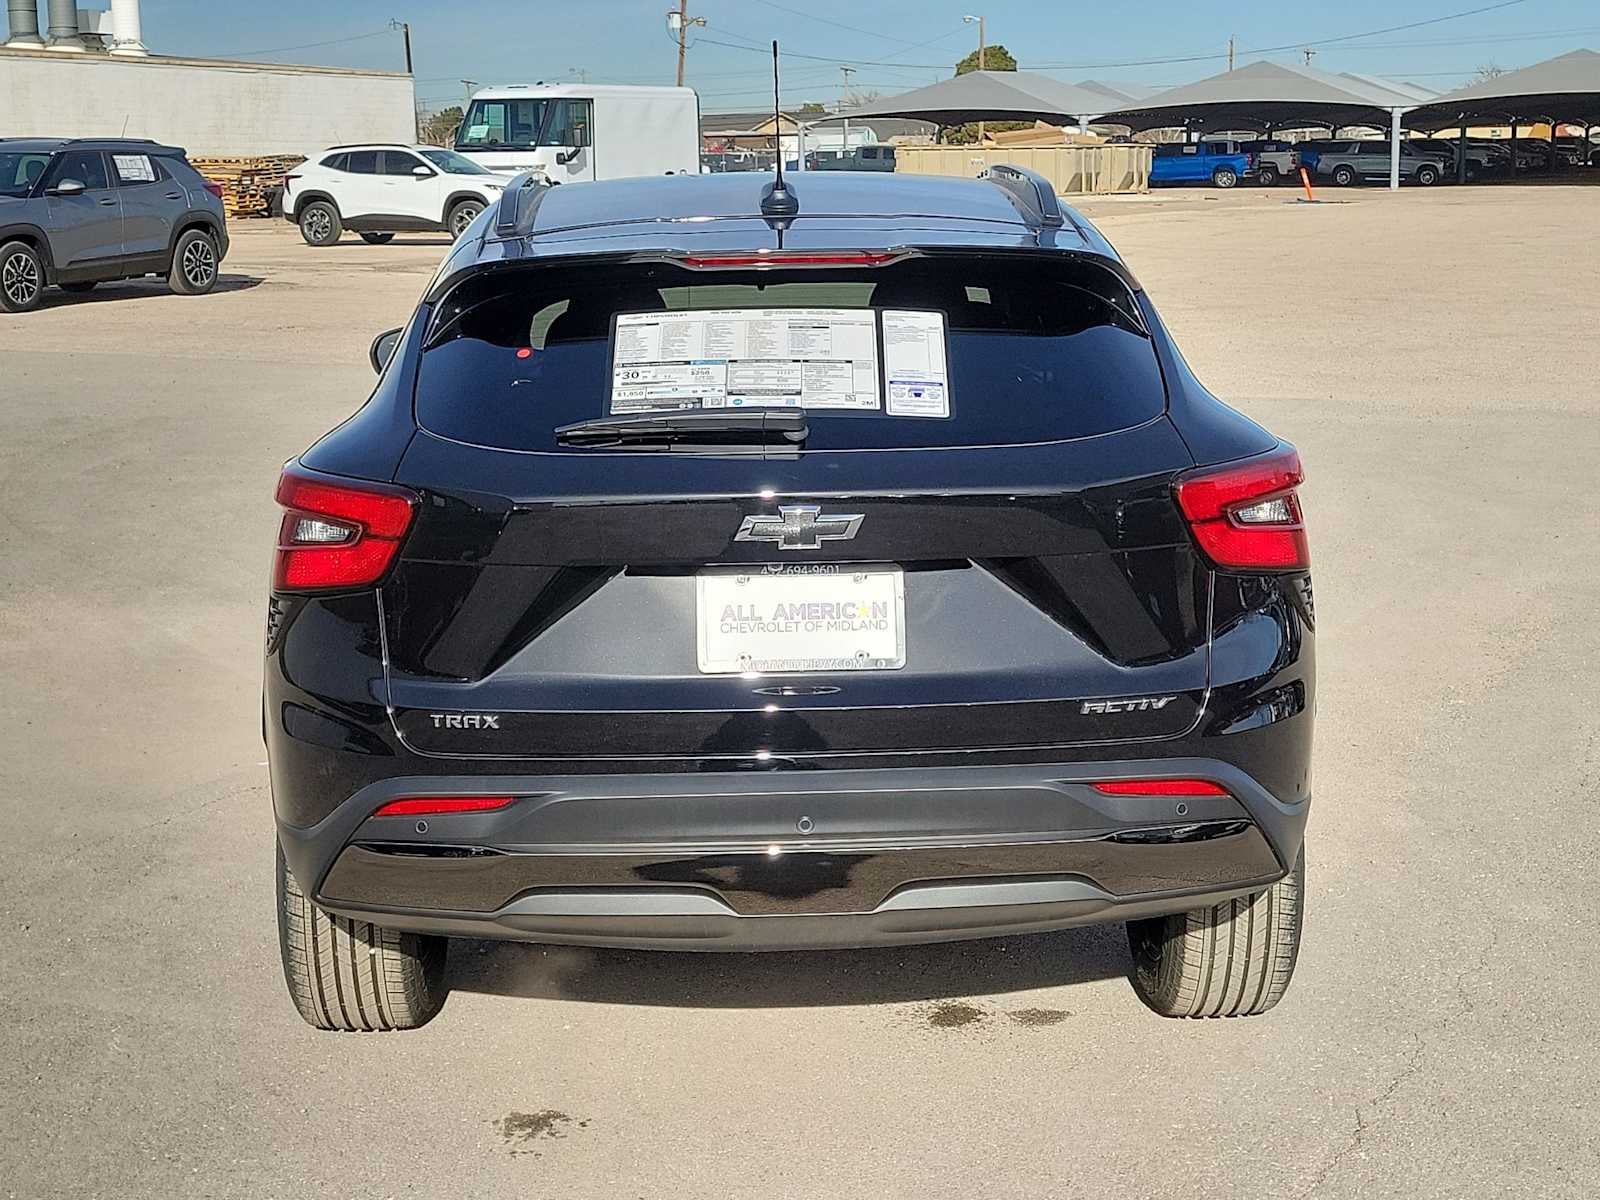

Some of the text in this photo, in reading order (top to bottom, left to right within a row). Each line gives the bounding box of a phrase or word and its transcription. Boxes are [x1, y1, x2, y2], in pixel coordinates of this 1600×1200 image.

[621, 371, 640, 380] 30
[760, 564, 840, 577] 42-694-9601
[720, 604, 763, 622] ALL
[720, 619, 889, 634] CHEVROLET OF MIDLAND
[1080, 695, 1178, 715] ACTIV
[430, 714, 500, 729] TRAX
